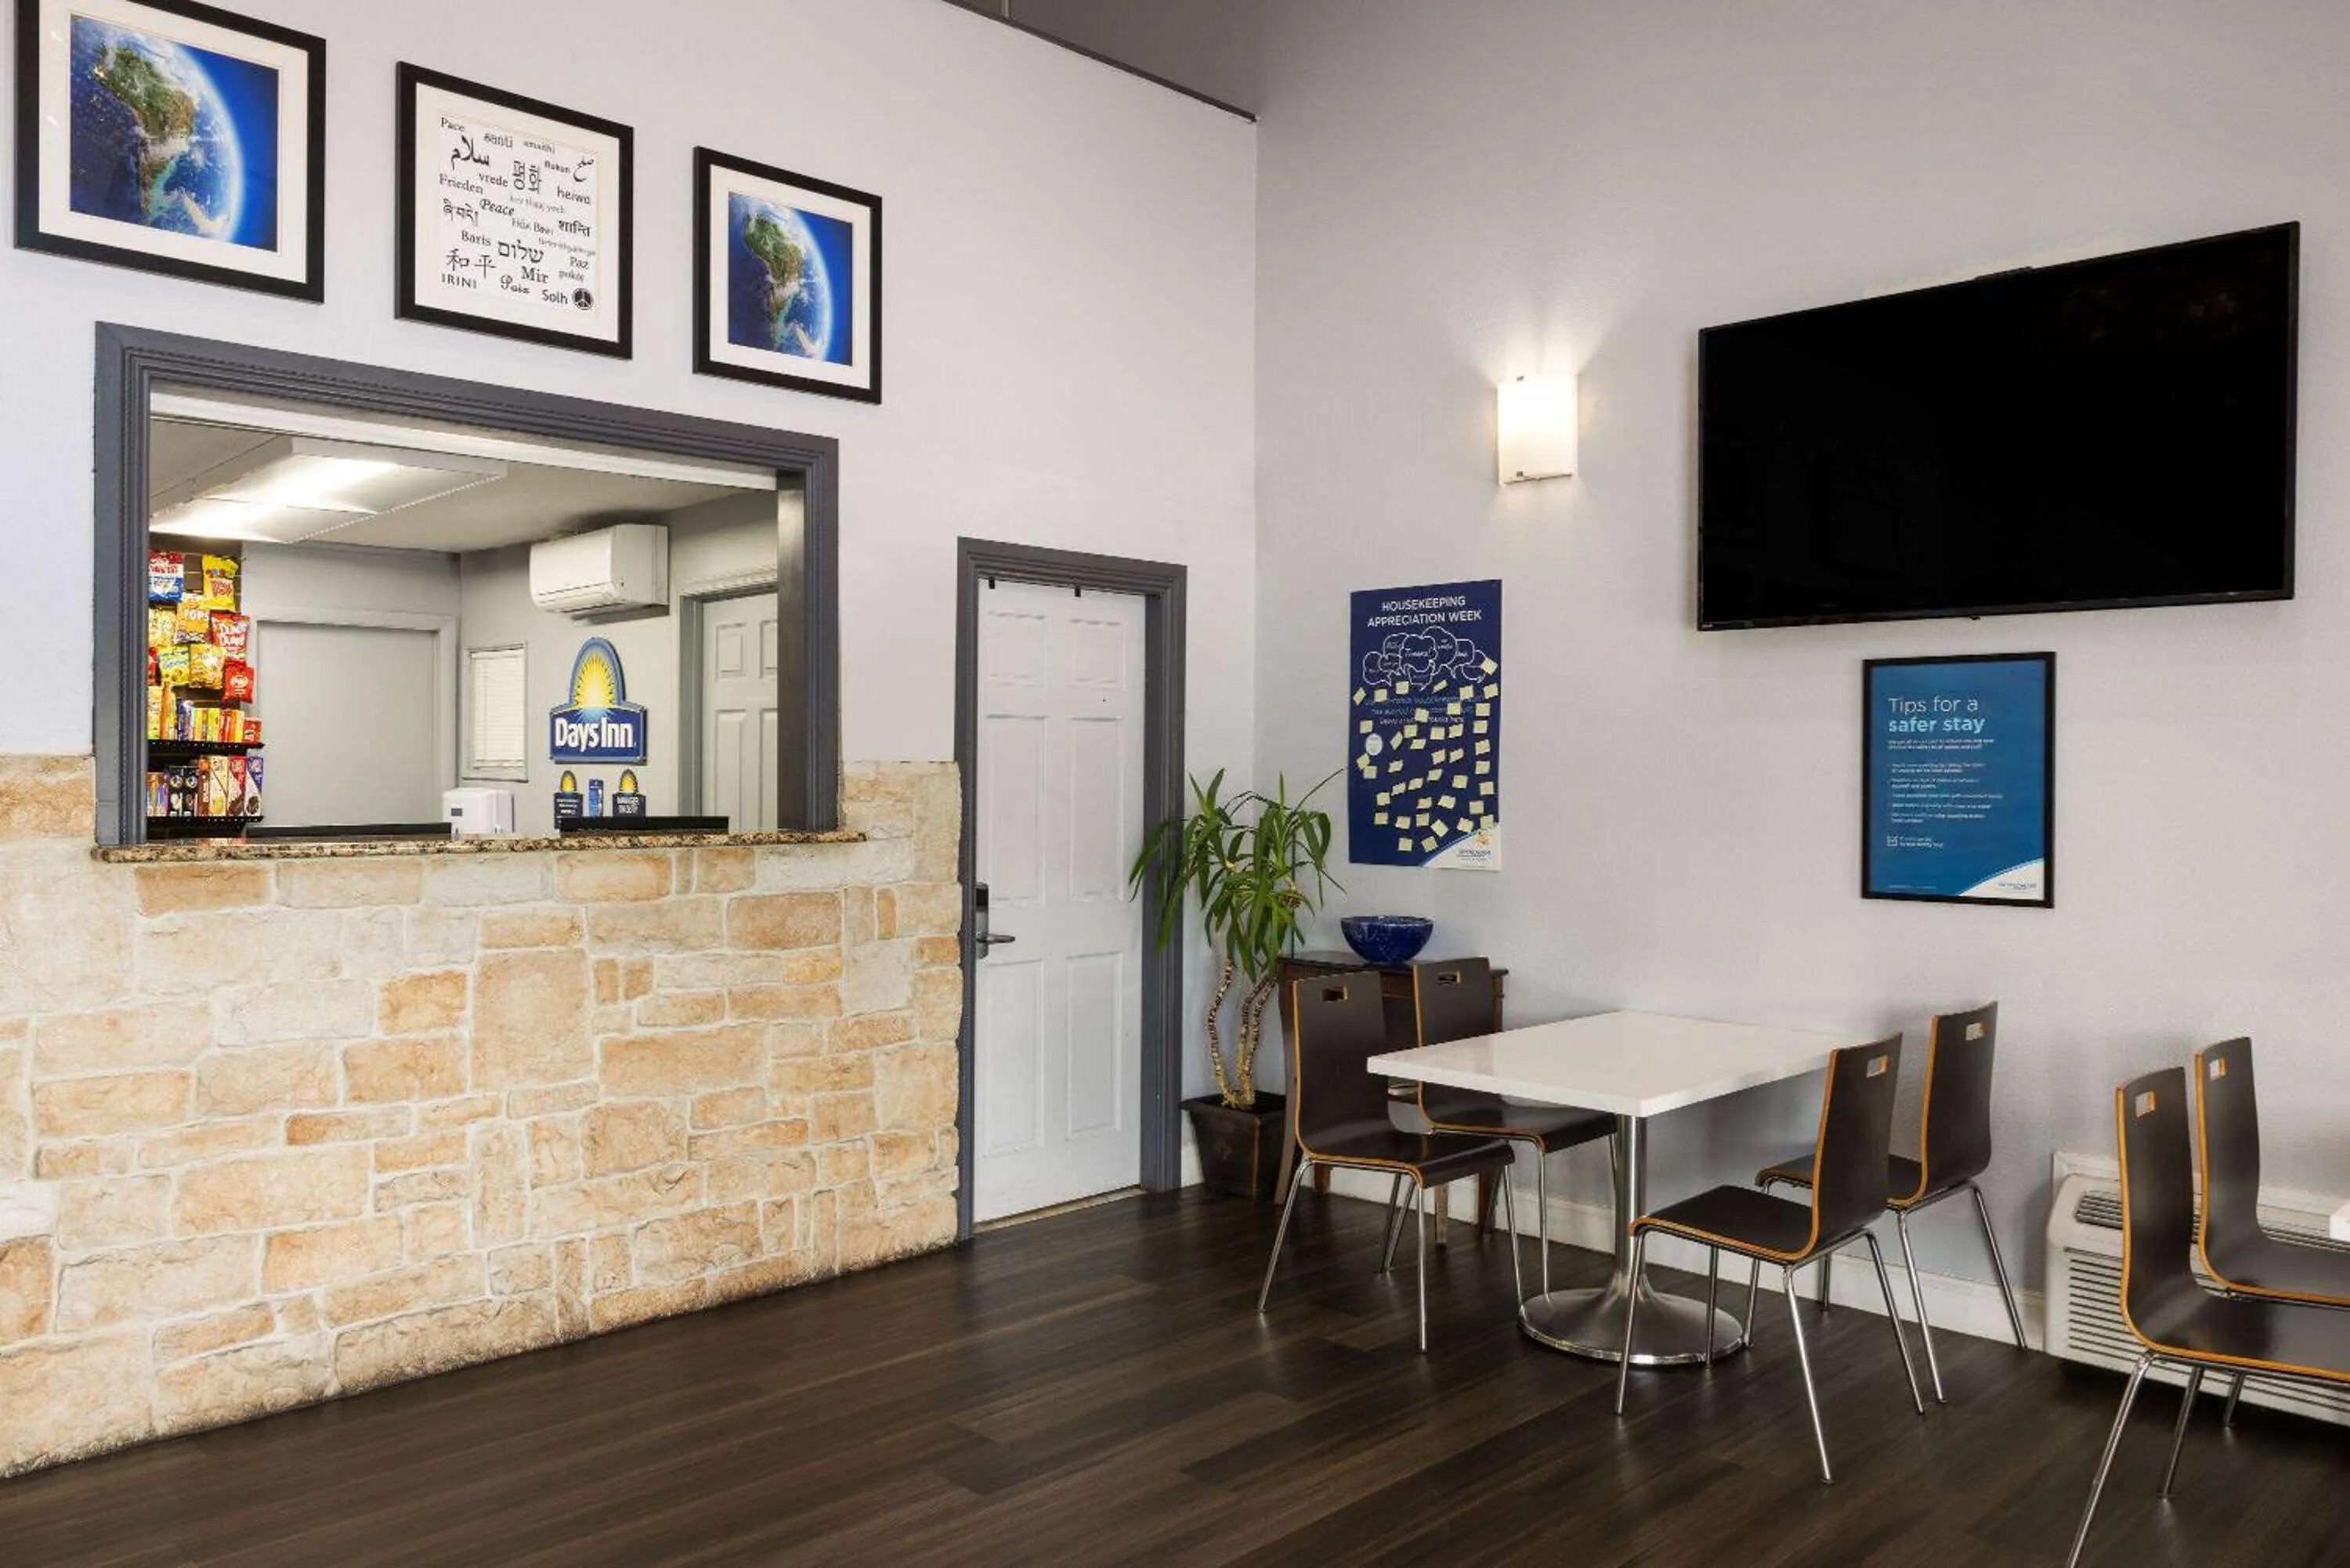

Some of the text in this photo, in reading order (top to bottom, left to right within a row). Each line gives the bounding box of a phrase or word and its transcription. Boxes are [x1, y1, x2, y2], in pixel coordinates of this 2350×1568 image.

[441, 117, 465, 132] Pace
[439, 173, 483, 194] Frieden
[479, 173, 508, 187] vrede
[479, 198, 515, 215] Peace
[498, 239, 544, 264] שלום
[446, 247, 497, 279] 和平
[441, 273, 477, 289] IRINI
[521, 266, 548, 283] Mir
[542, 289, 568, 305] Solh
[1382, 596, 1466, 612] HOUSEKEEPING
[1368, 610, 1482, 627] APPRECIATION WEEK
[1889, 695, 1978, 714] Tips for a
[1889, 716, 1986, 734] safer stay
[555, 717, 633, 752] Days Inn
